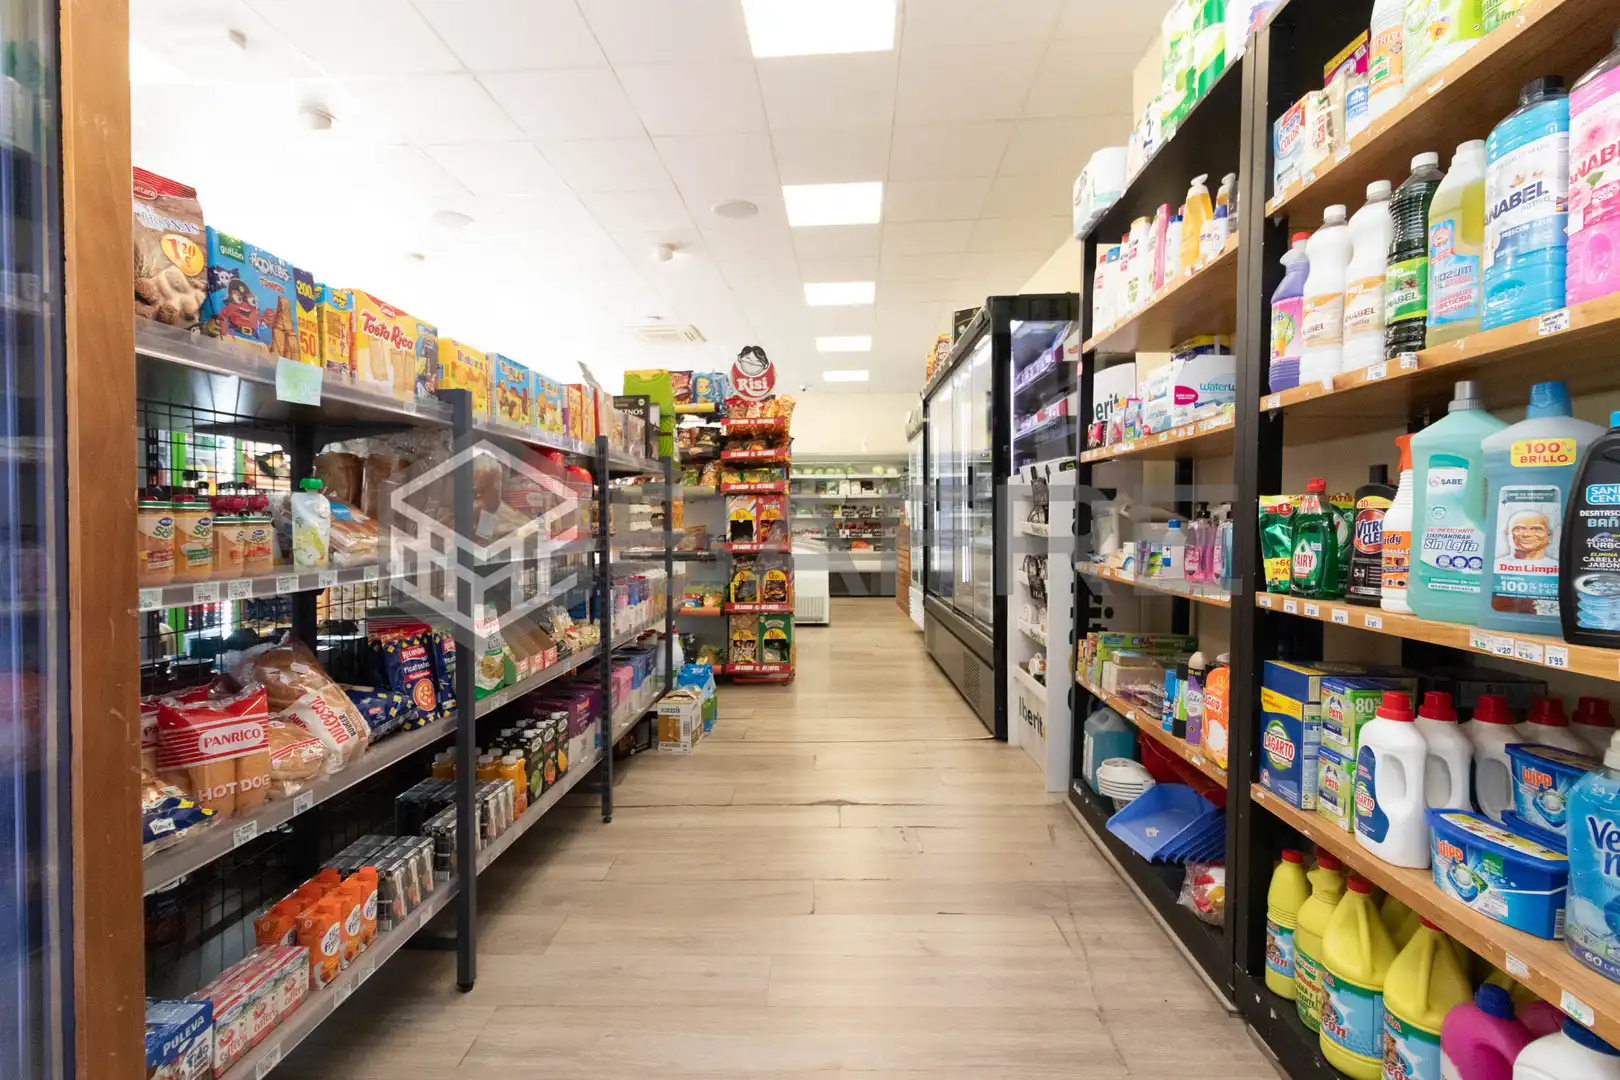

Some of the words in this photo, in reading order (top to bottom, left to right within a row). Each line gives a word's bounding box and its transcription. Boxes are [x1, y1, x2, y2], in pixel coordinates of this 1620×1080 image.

[361, 311, 391, 341] Tosta
[391, 325, 414, 350] Rica
[736, 377, 769, 392] Risi
[1520, 455, 1568, 463] BRILLO
[1424, 539, 1443, 550] Sin
[1294, 554, 1313, 567] FAIRY
[1500, 564, 1522, 572] Don
[1328, 706, 1344, 722] PATO
[203, 729, 261, 749] PANRICO
[1263, 731, 1295, 760] LAGARTO
[199, 781, 238, 803] HOT
[240, 774, 271, 792] DOG
[1324, 775, 1340, 792] PATO
[1585, 952, 1602, 966] 60
[162, 1015, 205, 1057] PULEVA
